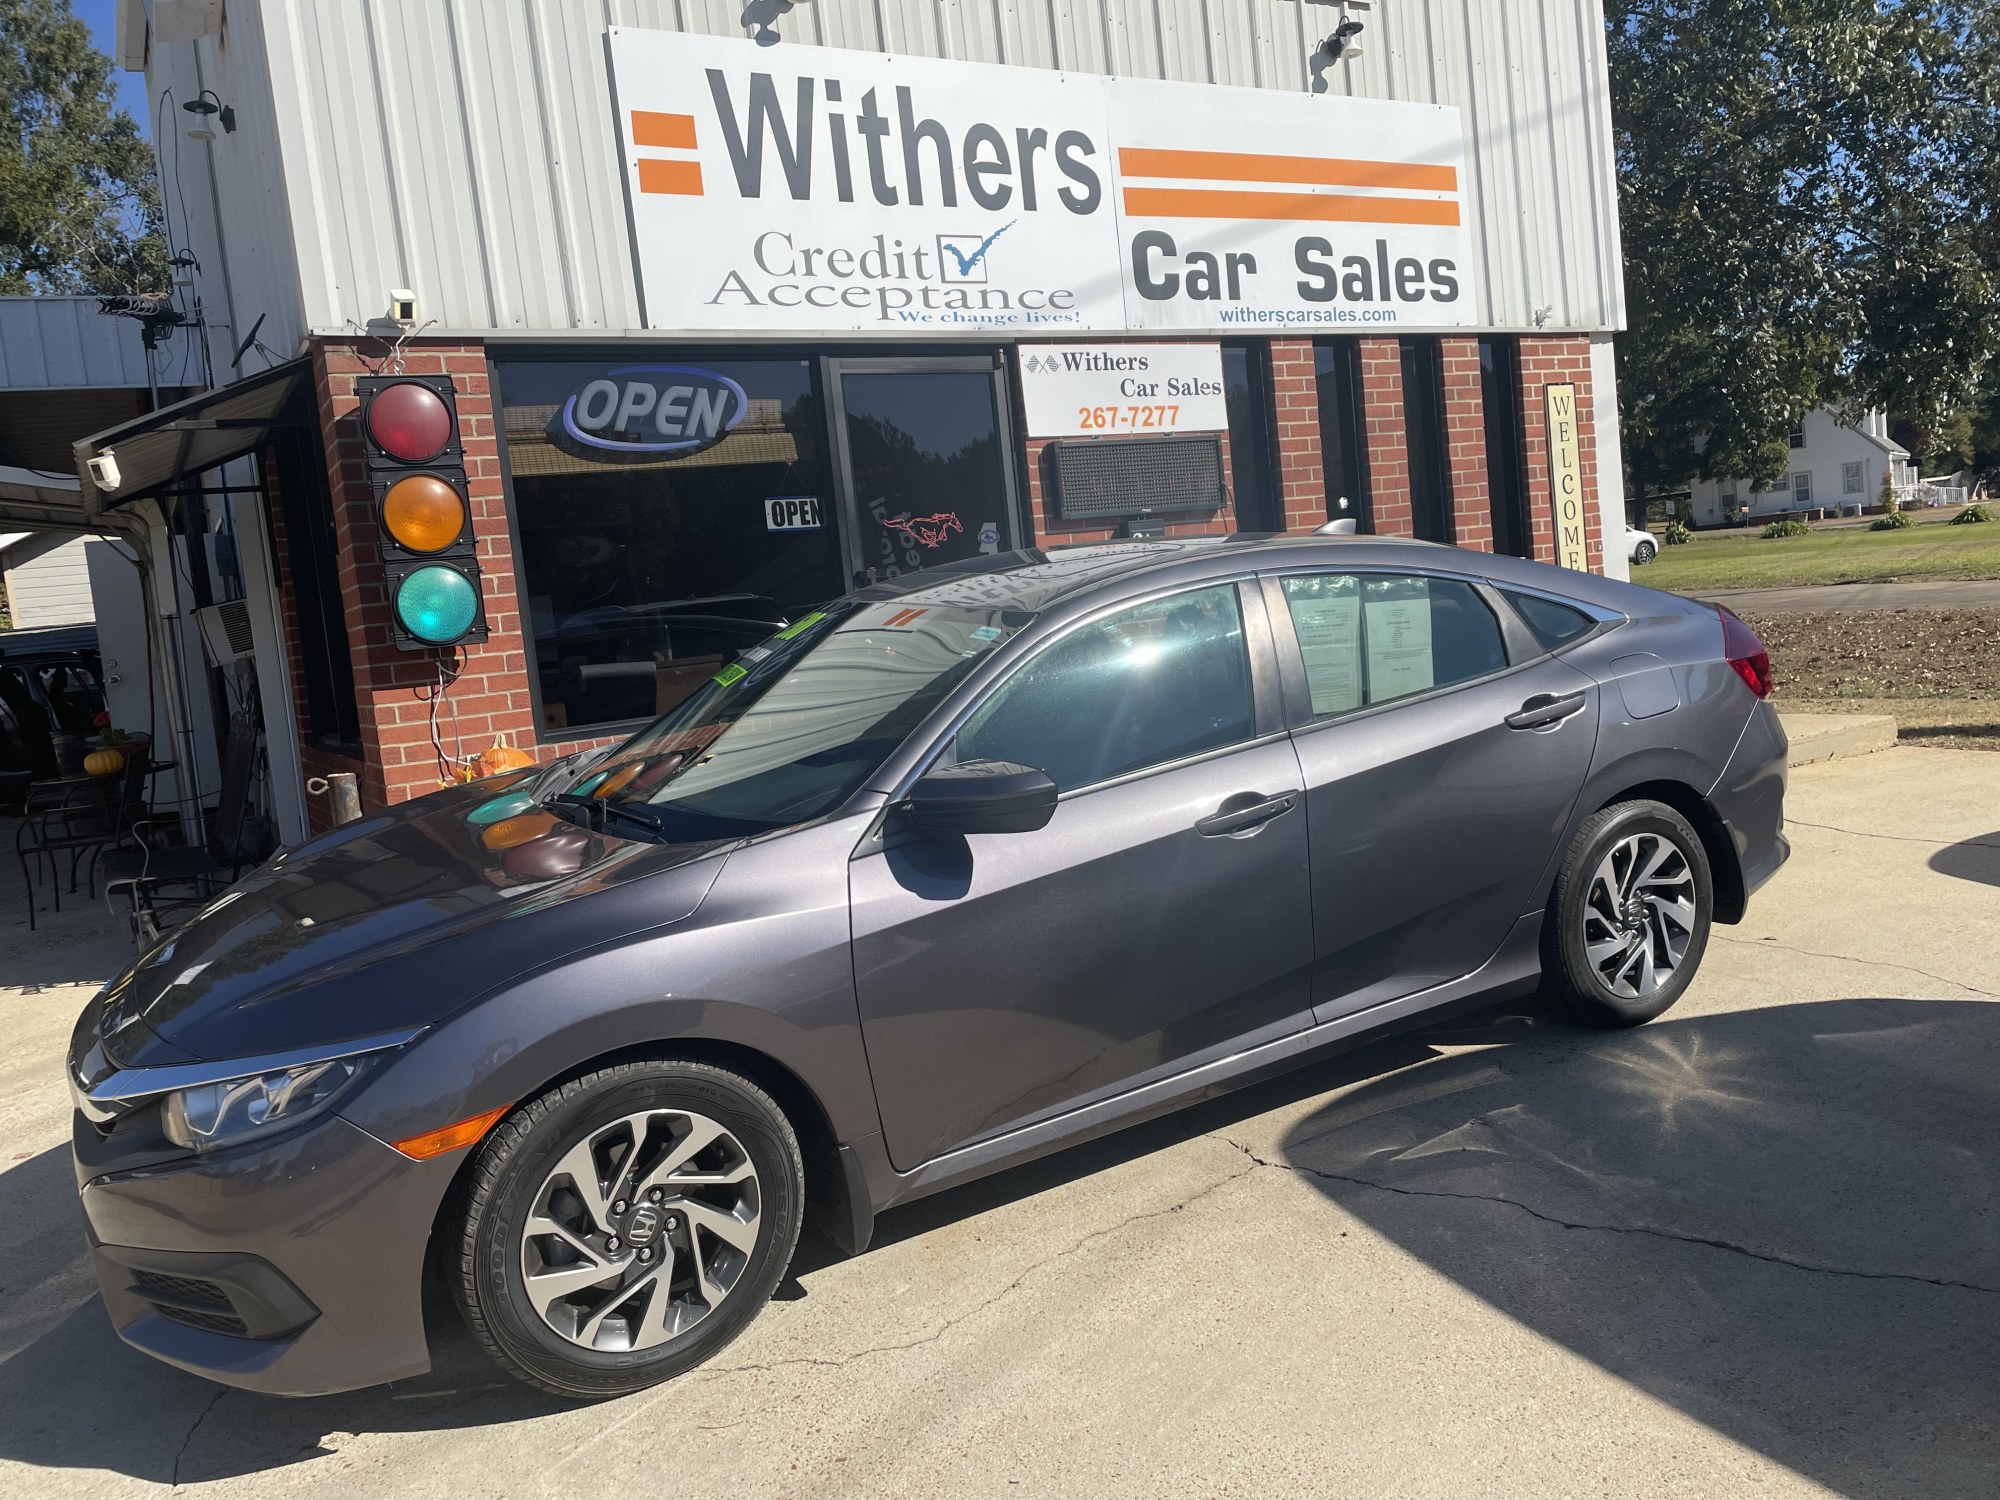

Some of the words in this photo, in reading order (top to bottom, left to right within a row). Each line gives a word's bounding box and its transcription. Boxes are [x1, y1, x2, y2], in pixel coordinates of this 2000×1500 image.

[705, 68, 1101, 215] Withers
[753, 231, 933, 280] Credit
[1131, 230, 1257, 301] Car
[1294, 236, 1459, 303] Sales
[703, 269, 1075, 321] Acceptance
[897, 310, 933, 323] We
[940, 311, 1018, 326] change
[1026, 311, 1080, 323] lives!
[1220, 306, 1397, 323] witherscarsales.com
[1061, 352, 1149, 371] Withers
[1120, 378, 1159, 397] Car
[1167, 377, 1222, 396] Sales
[576, 379, 729, 439] OPEN
[1078, 405, 1180, 429] 267-7277
[1552, 395, 1580, 571] WELCOME
[771, 500, 823, 527] OPEN
